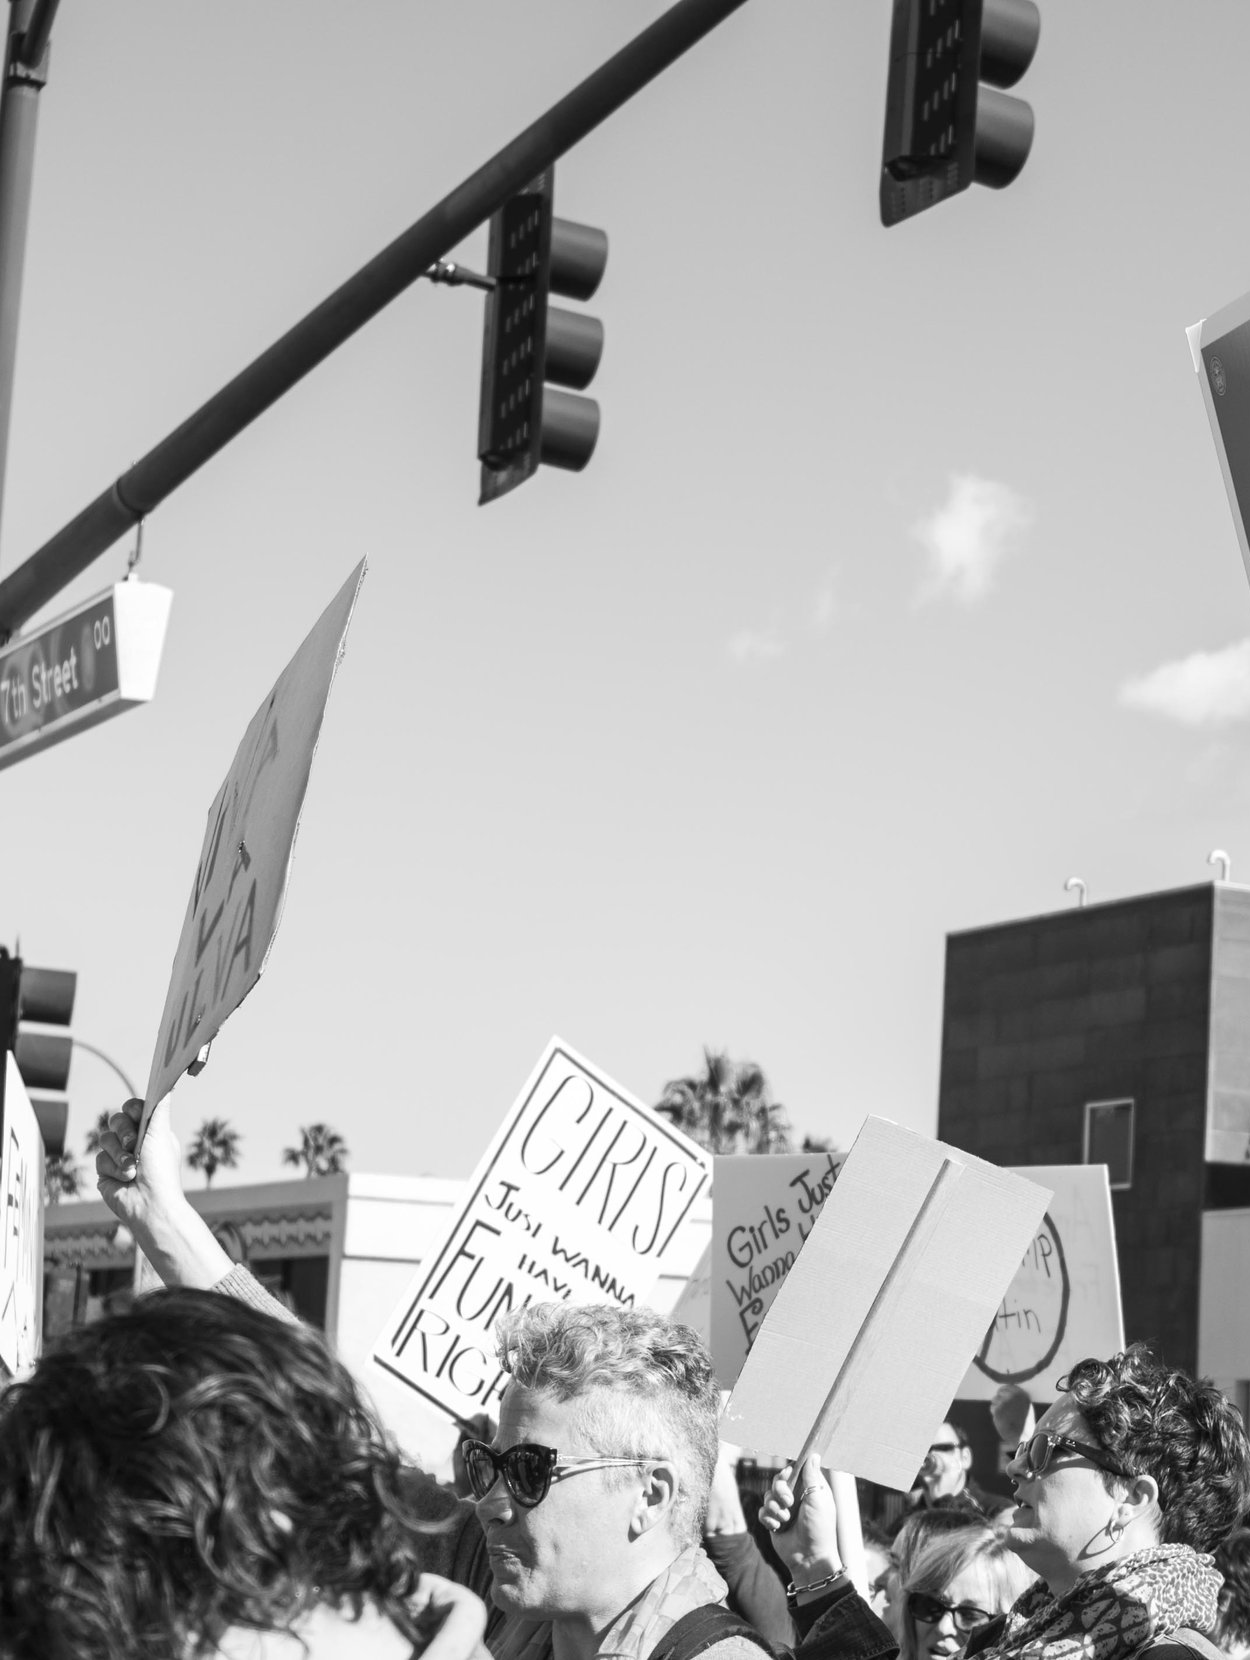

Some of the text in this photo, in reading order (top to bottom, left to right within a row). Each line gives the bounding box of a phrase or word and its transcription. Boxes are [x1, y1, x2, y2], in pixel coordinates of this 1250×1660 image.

[1, 646, 79, 724] 7th Street
[156, 877, 256, 1079] ULVA
[727, 1204, 791, 1268] Girls
[789, 1154, 841, 1214] Just
[428, 1218, 532, 1331] FUN
[551, 1235, 636, 1308] WANNA
[726, 1250, 796, 1307] Wanna
[396, 1308, 509, 1406] RIGH
[996, 1298, 1042, 1335] tin
